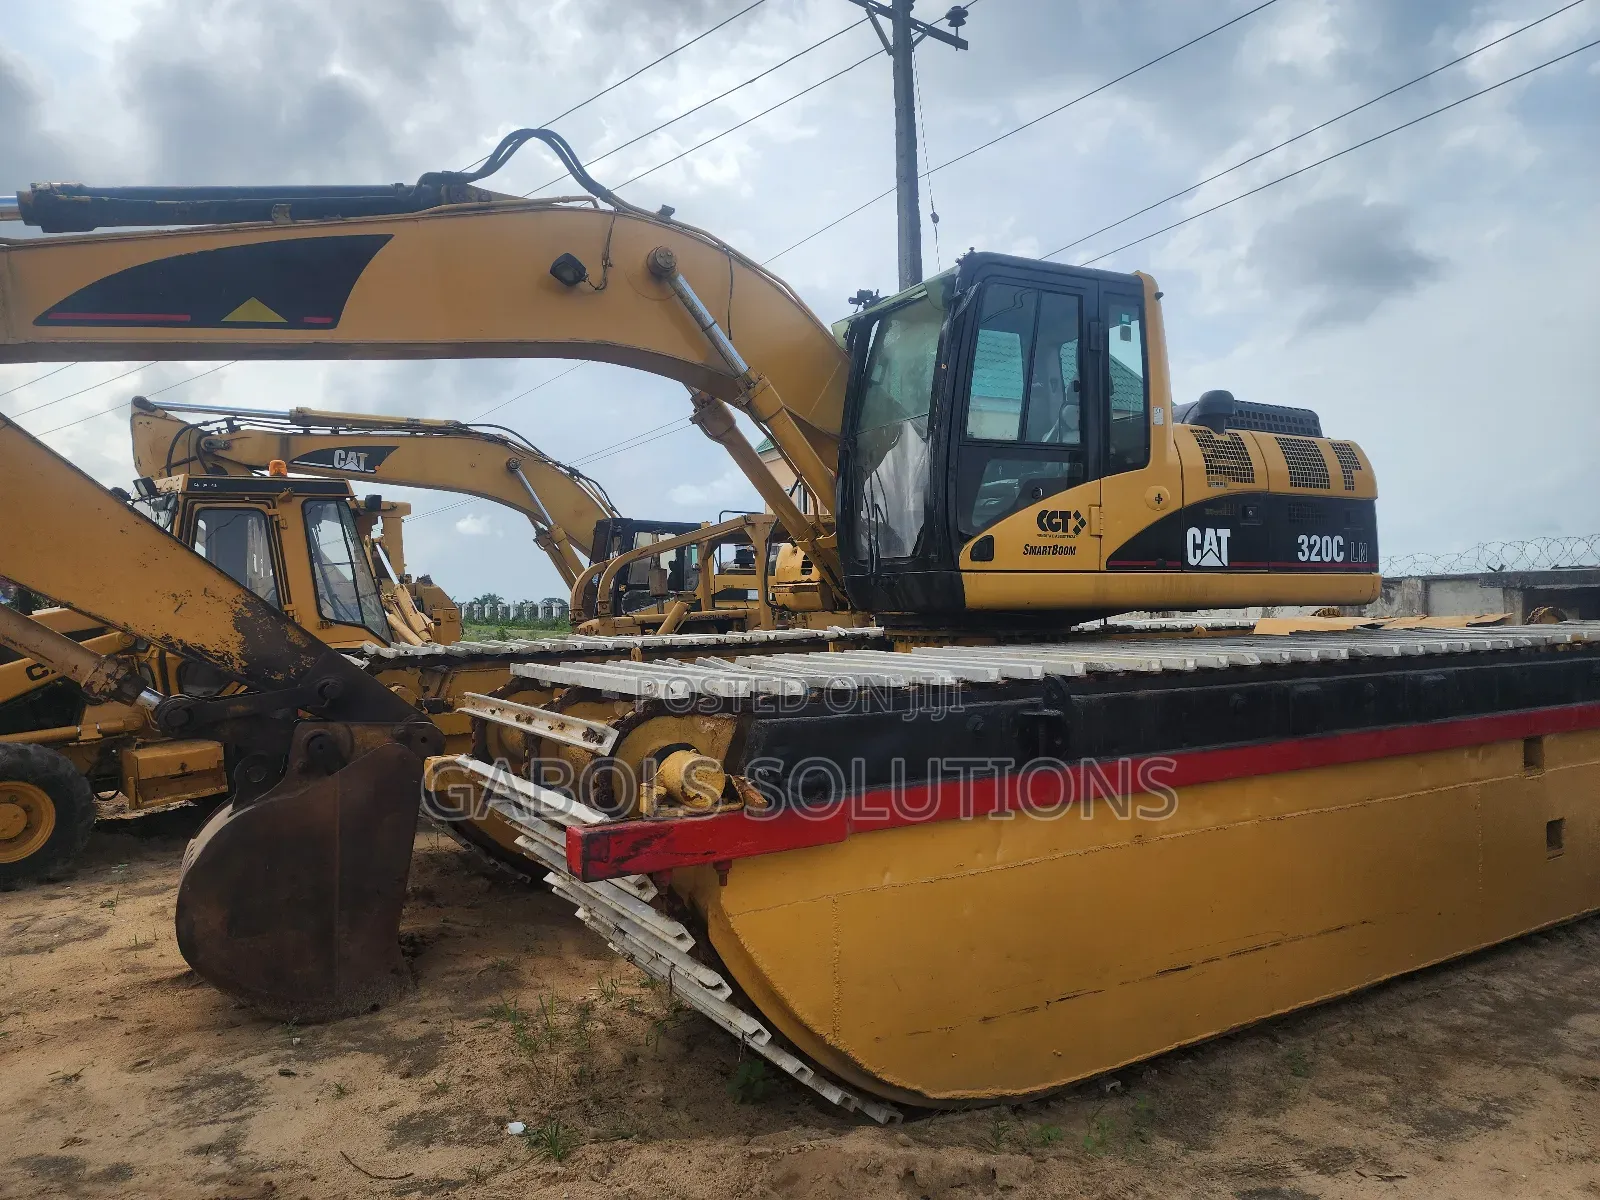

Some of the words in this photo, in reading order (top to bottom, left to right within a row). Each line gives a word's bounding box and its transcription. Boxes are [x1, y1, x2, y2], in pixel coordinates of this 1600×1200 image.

[333, 449, 369, 472] CAT
[1186, 526, 1231, 567] CAT
[1297, 534, 1344, 563] 320C
[1350, 541, 1368, 563] LN
